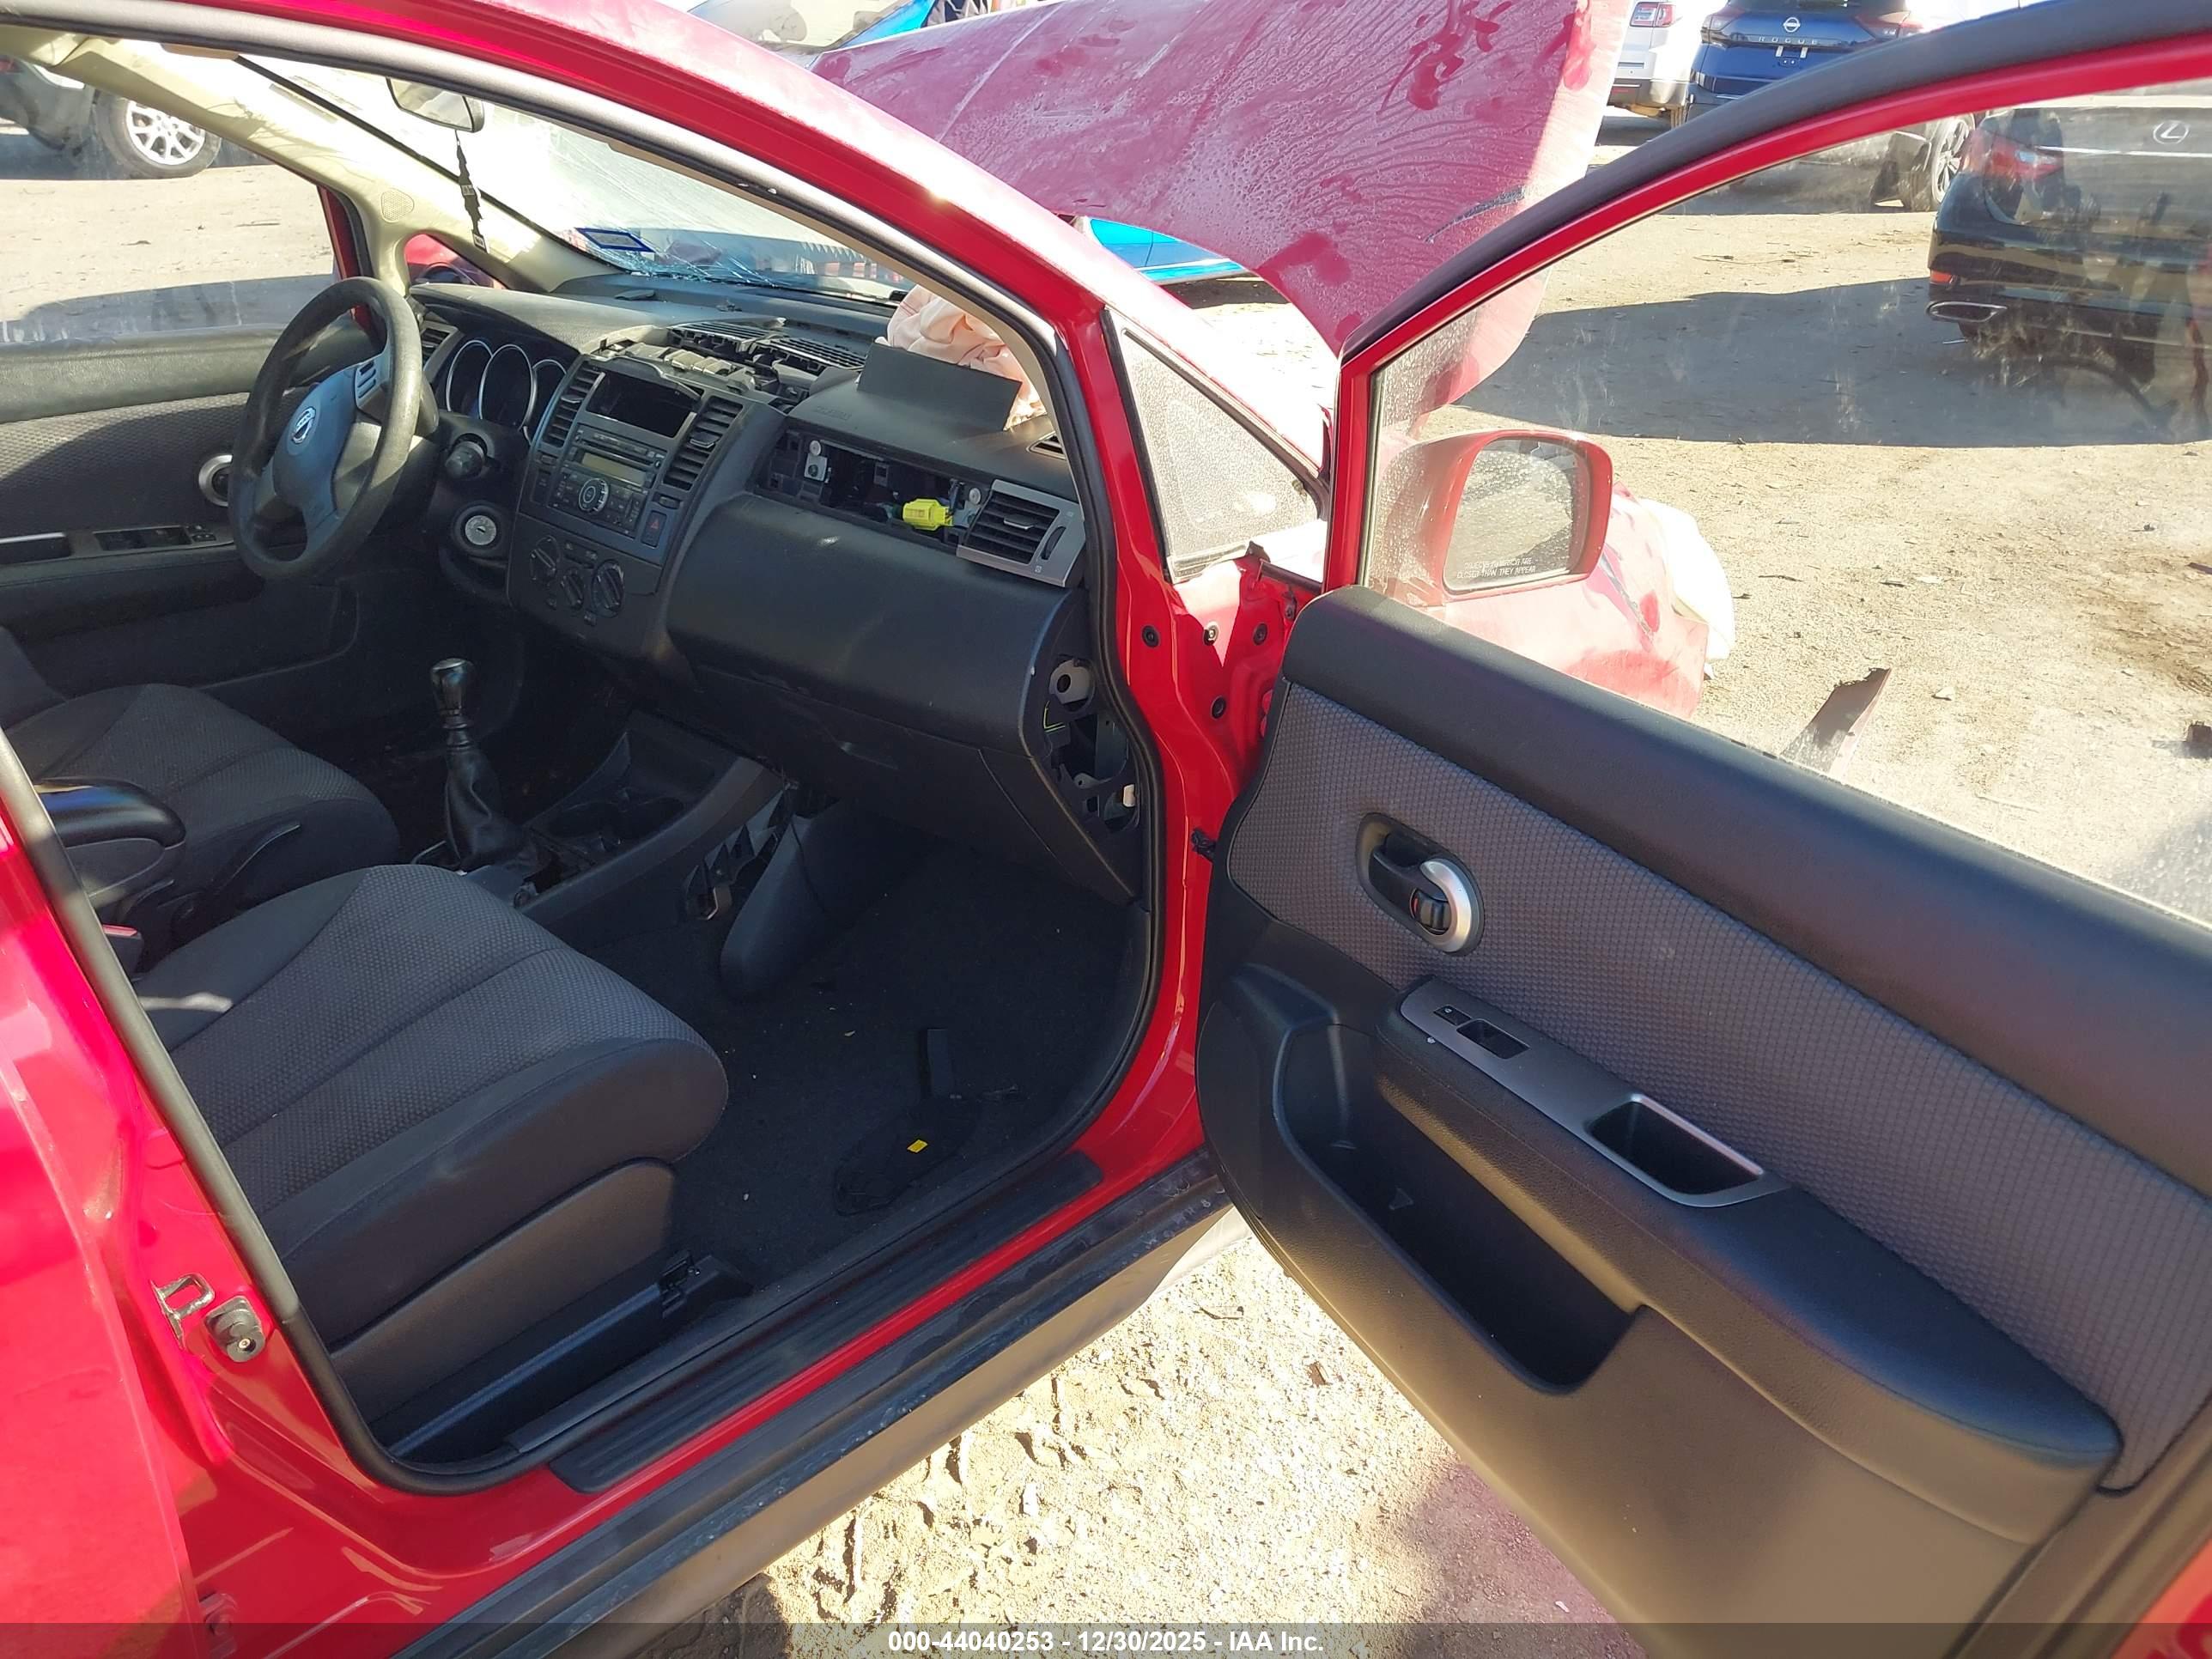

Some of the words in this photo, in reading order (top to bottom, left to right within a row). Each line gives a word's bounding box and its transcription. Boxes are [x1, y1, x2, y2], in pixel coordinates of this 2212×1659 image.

[1759, 36, 1818, 45] ROGUE
[1521, 556, 1533, 565] ARE
[1498, 567, 1514, 576] THEY
[1514, 566, 1536, 575] APPEAR
